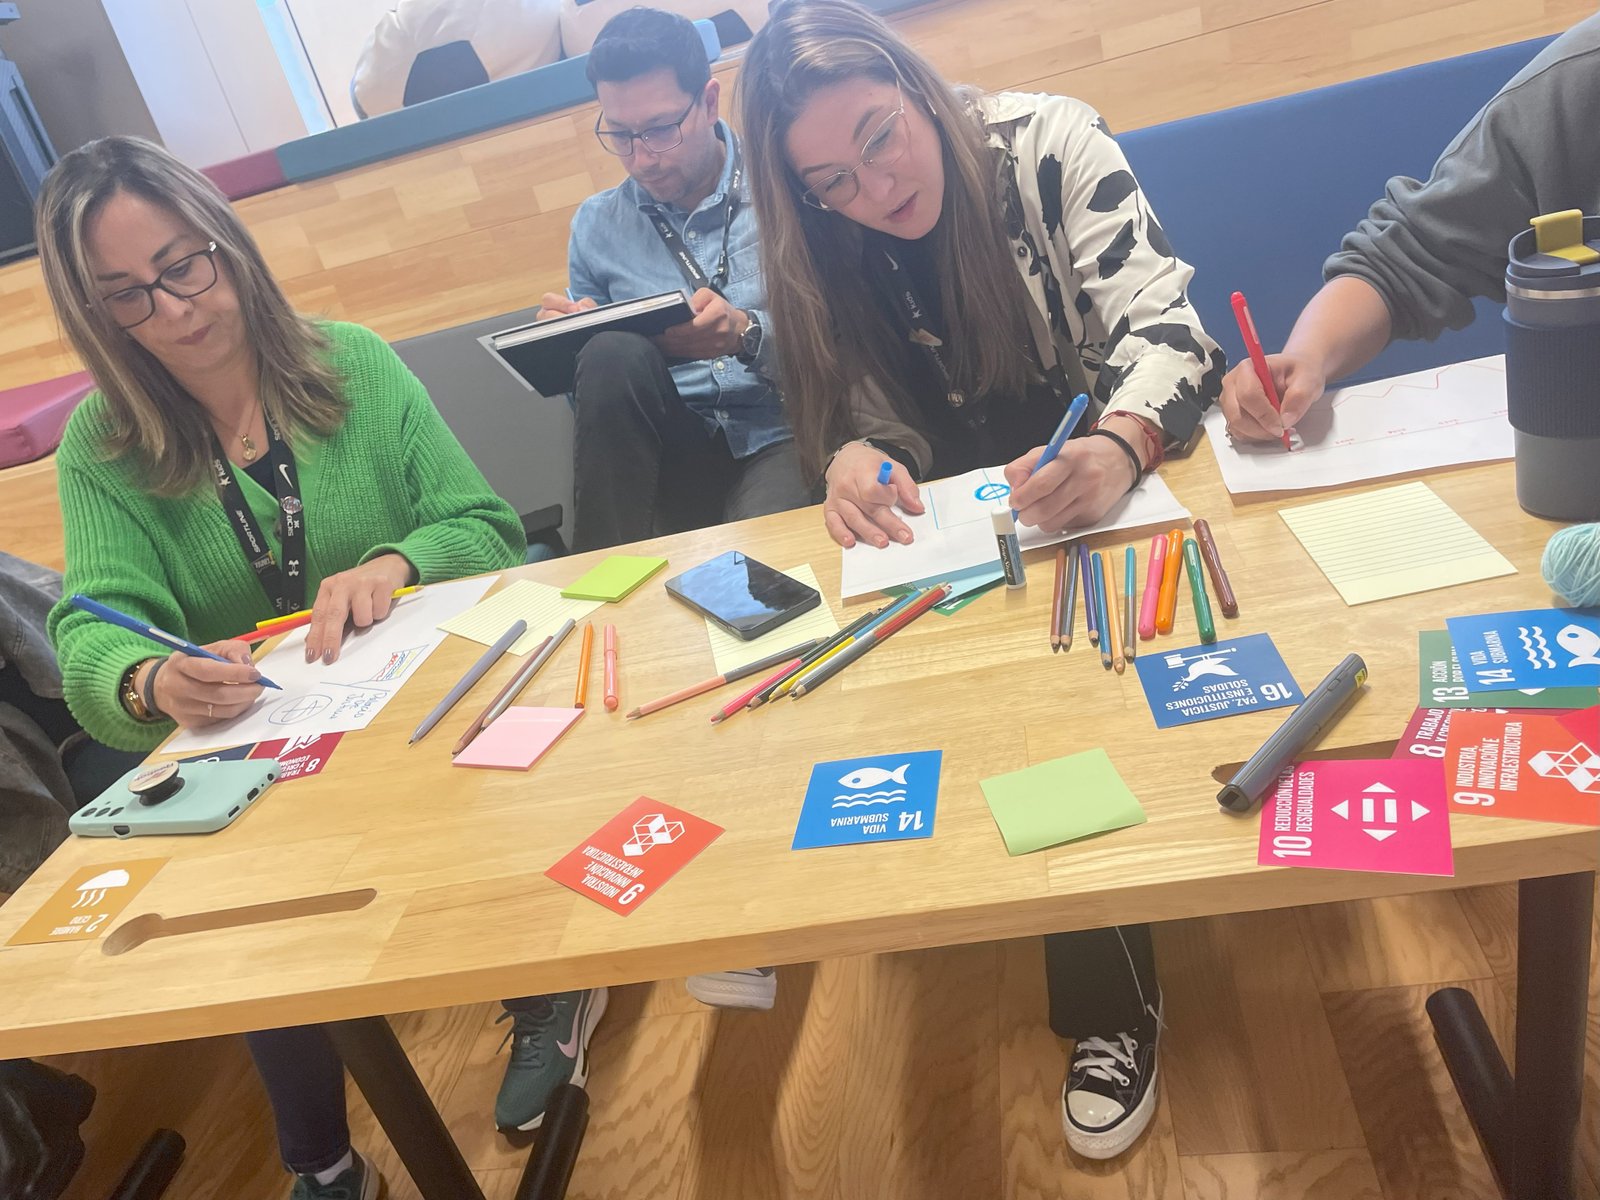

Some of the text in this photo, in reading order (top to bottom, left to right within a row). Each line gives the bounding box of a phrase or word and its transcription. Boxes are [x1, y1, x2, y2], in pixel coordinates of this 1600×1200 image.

[214, 458, 227, 479] kids
[235, 509, 261, 554] SPORTLINE
[1483, 630, 1509, 664] SUBMARINA
[1469, 650, 1488, 666] VIDA
[1429, 660, 1448, 683] ACCIÓN
[1475, 668, 1516, 685] 14
[1165, 687, 1254, 711] E INSTITUCIONES
[1260, 682, 1293, 701] 16
[1432, 686, 1470, 703] 13
[1181, 700, 1230, 716] JUSTICIA
[1415, 708, 1445, 740] TRABAJO
[1409, 743, 1446, 758] 8
[1499, 721, 1523, 791] INFRAESTRUCTURA
[305, 758, 321, 772] 8
[1456, 745, 1479, 787] INDUSTRIA,
[1477, 748, 1499, 789] INNOVACIÓN
[1296, 771, 1315, 832] DESIGUALDADES
[1453, 792, 1495, 806] 9
[830, 813, 889, 827] SUBMARINA
[898, 810, 924, 831] 14
[1274, 788, 1293, 832] REDUCCIÓN
[863, 824, 886, 835] VIDA
[1272, 835, 1312, 858] 10
[582, 845, 645, 879] INFRAESTRUCTURA
[618, 883, 645, 905] 9
[85, 913, 109, 933] 2
